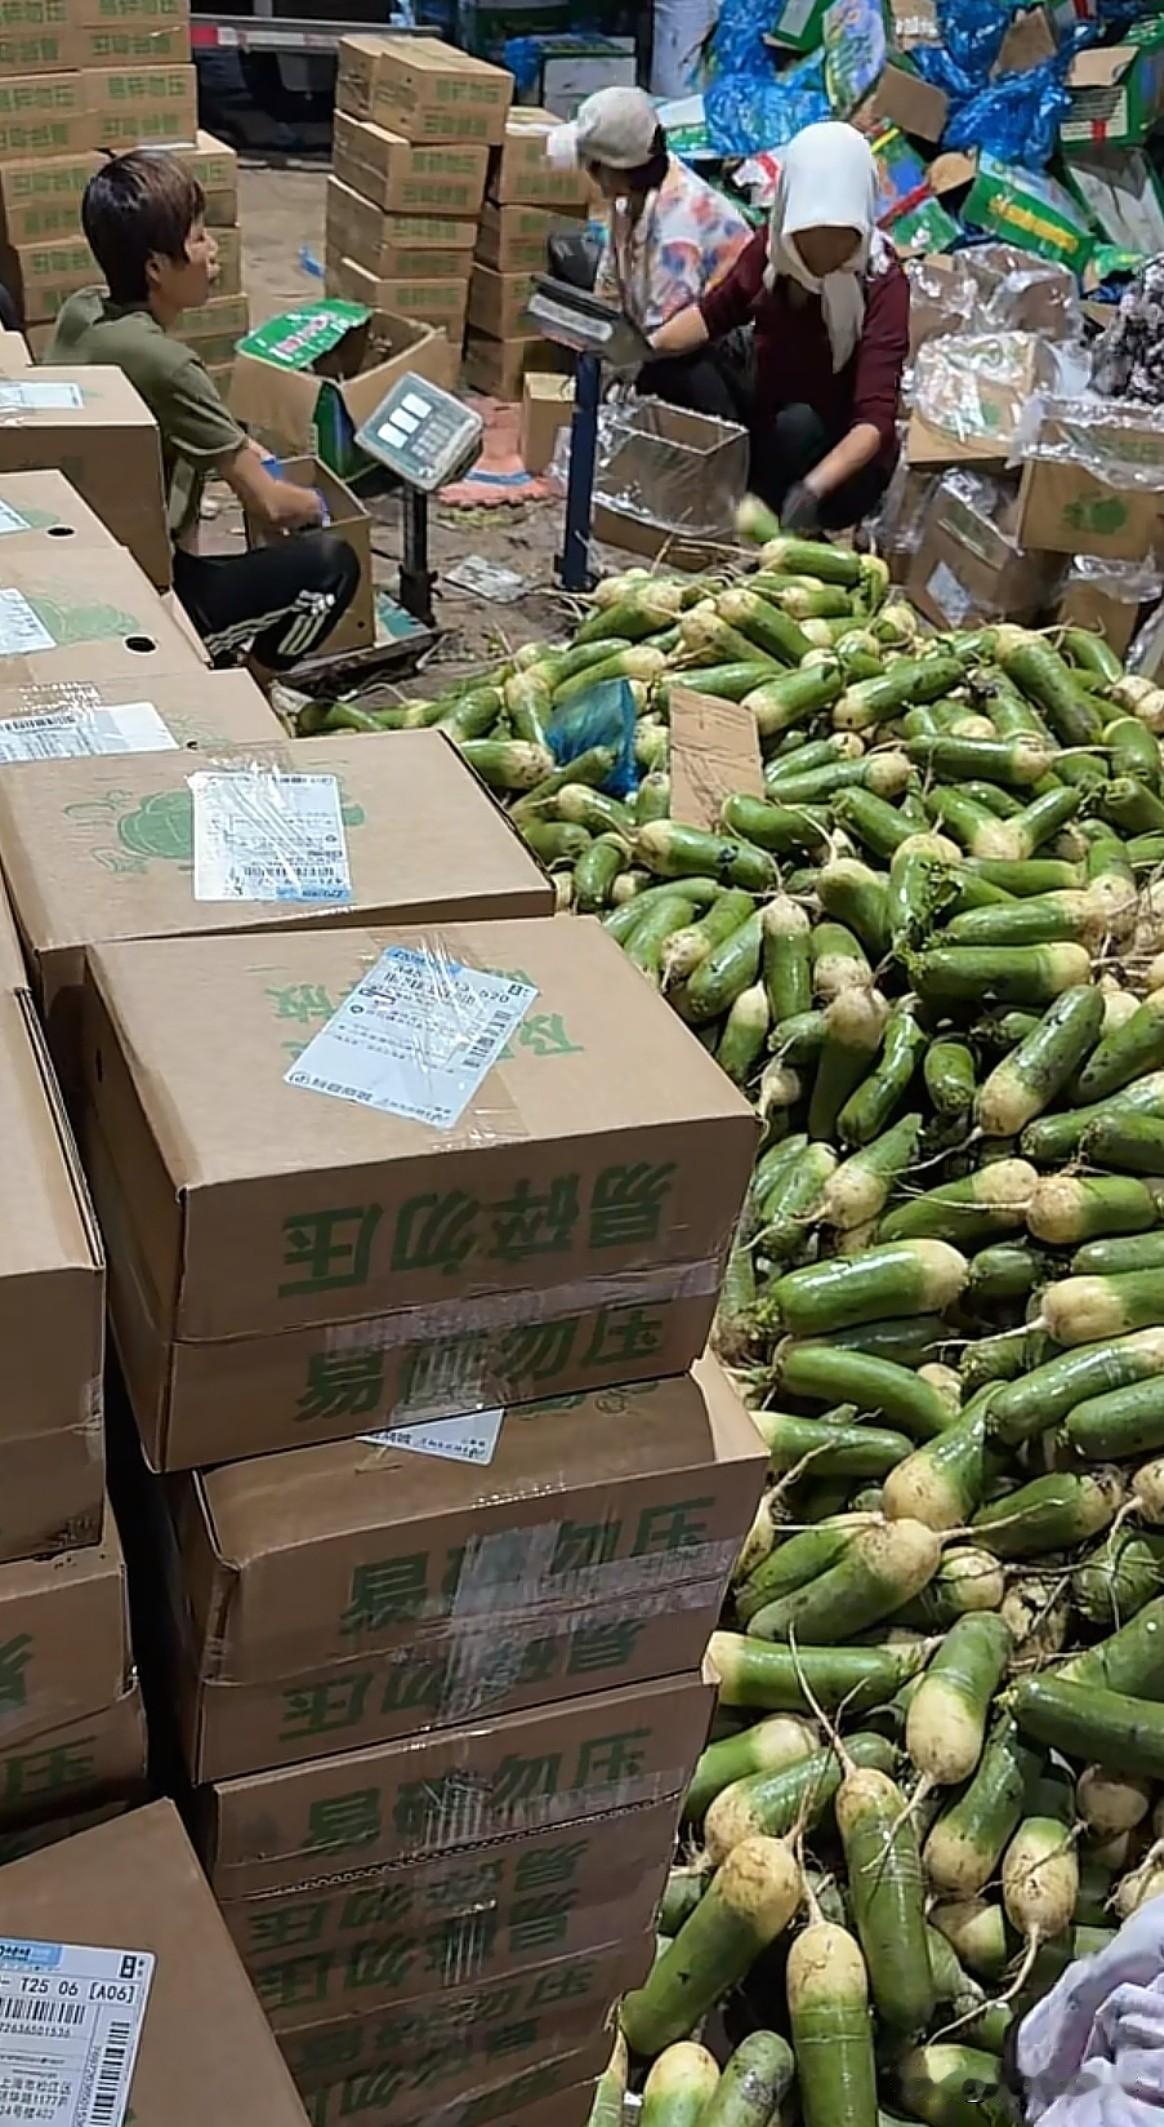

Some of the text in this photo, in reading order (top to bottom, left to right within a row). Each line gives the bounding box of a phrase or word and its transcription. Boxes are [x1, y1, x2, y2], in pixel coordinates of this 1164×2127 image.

[277, 1162, 677, 1298] 易碎勿压
[338, 1497, 718, 1640] 易勿压
[21, 1978, 49, 1994] T25
[58, 1980, 79, 1996] 06
[89, 1982, 136, 2003] [A06]
